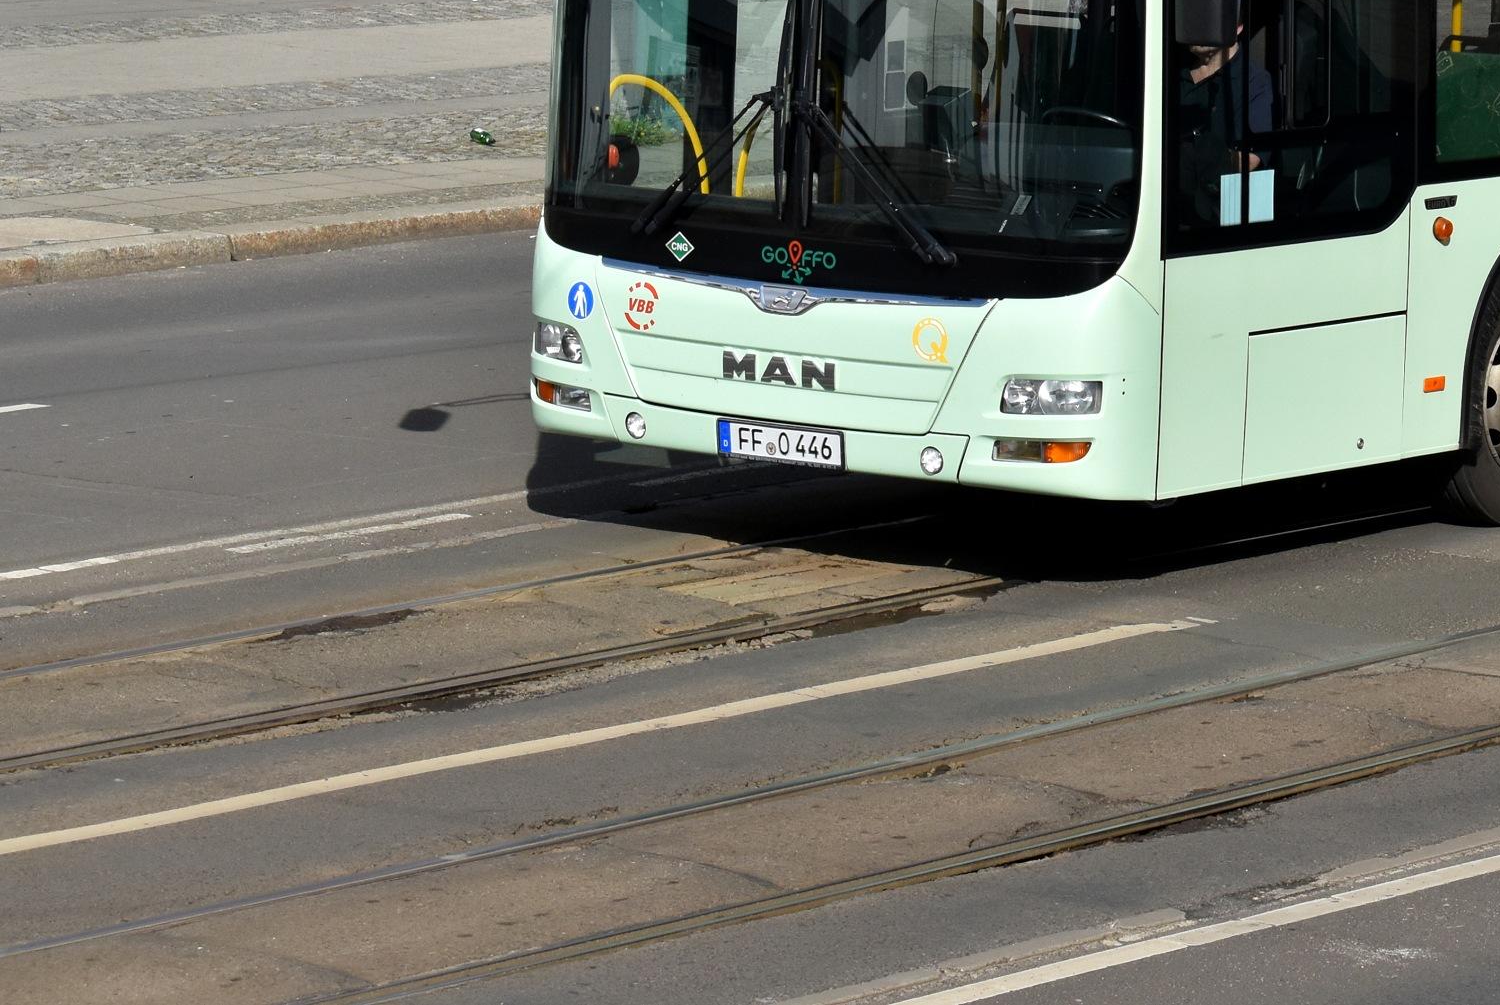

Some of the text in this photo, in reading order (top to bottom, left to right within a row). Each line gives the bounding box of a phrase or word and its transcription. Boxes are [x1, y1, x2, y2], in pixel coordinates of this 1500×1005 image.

[670, 241, 689, 252] CNG
[628, 297, 655, 315] VBB
[722, 350, 836, 392] MAN
[738, 427, 763, 452] FF
[795, 434, 833, 460] 446
